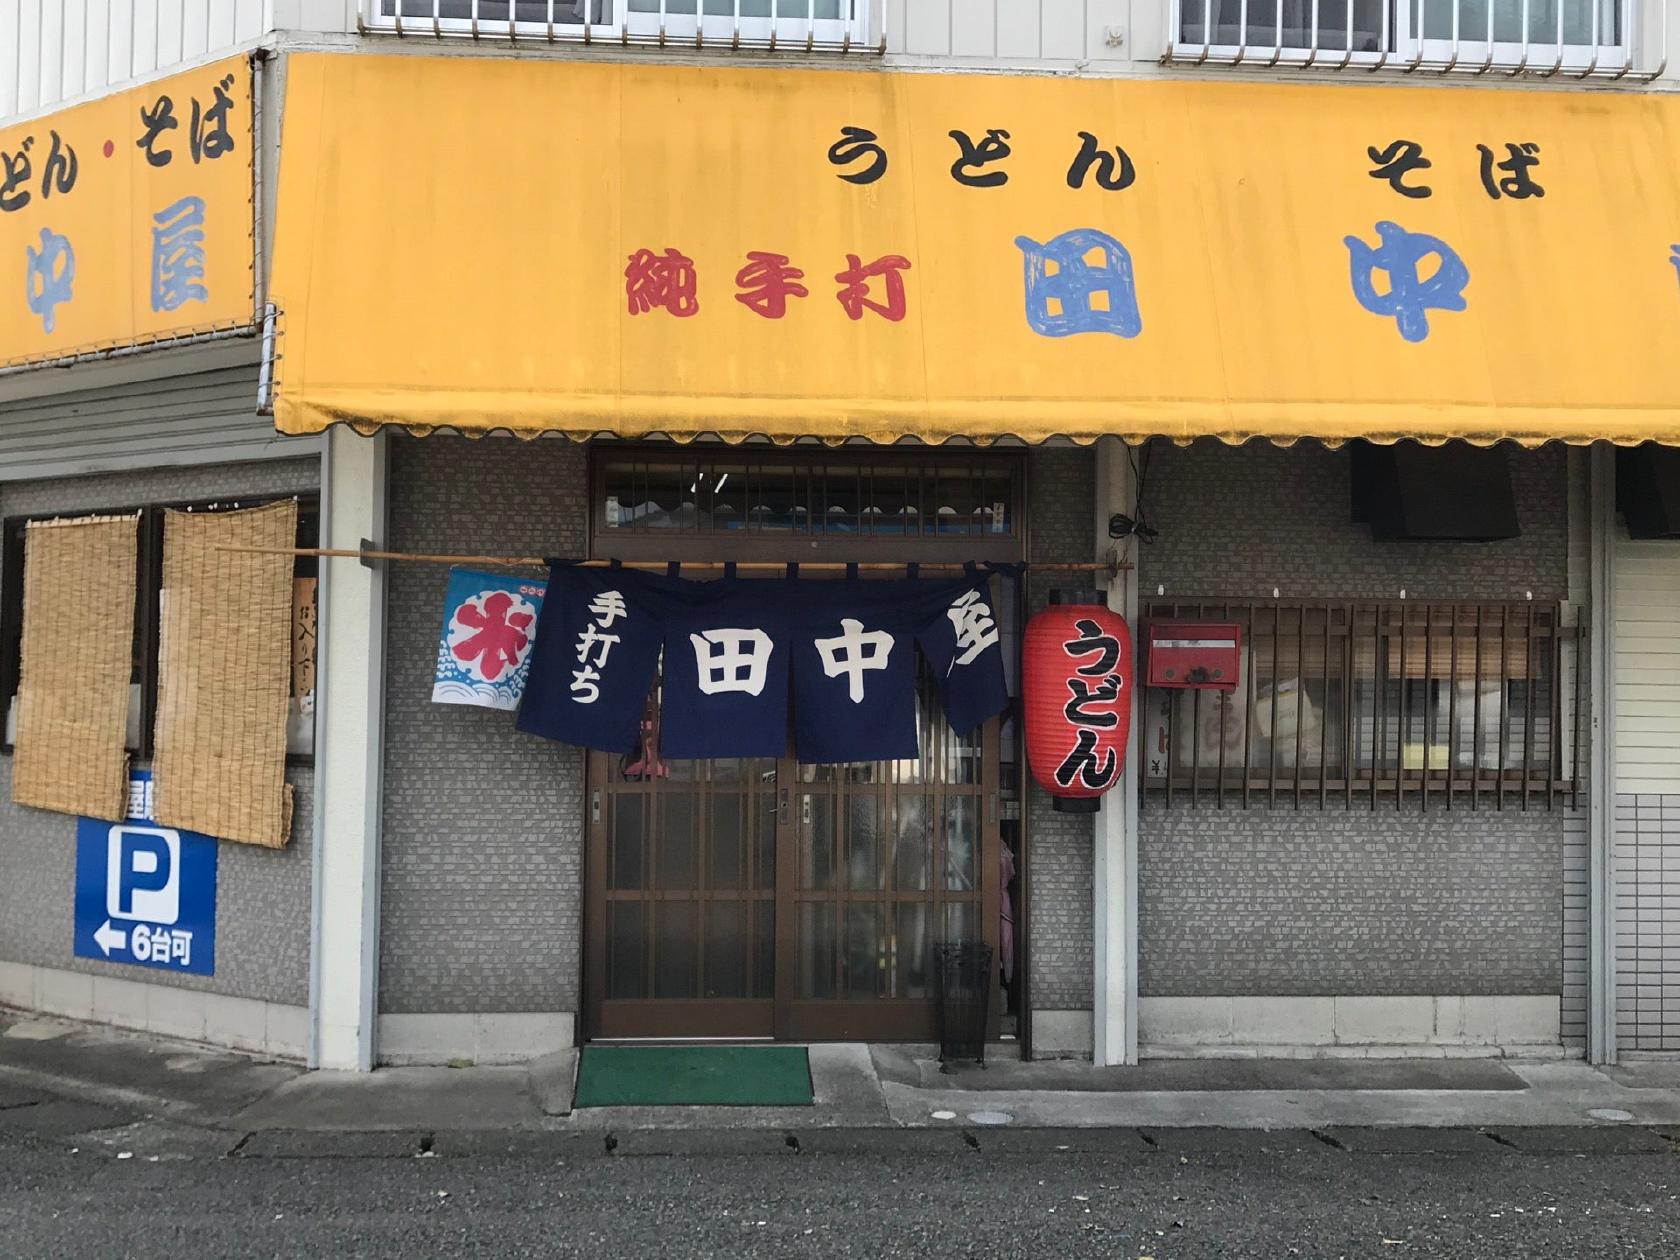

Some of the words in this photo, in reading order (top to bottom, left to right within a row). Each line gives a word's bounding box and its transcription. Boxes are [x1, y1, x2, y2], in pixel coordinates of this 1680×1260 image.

[828, 126, 1136, 191] うどん
[1367, 140, 1545, 200] そば
[570, 590, 628, 704] 手打ち
[1054, 619, 1123, 790] うどん
[130, 926, 193, 967] 6台可
